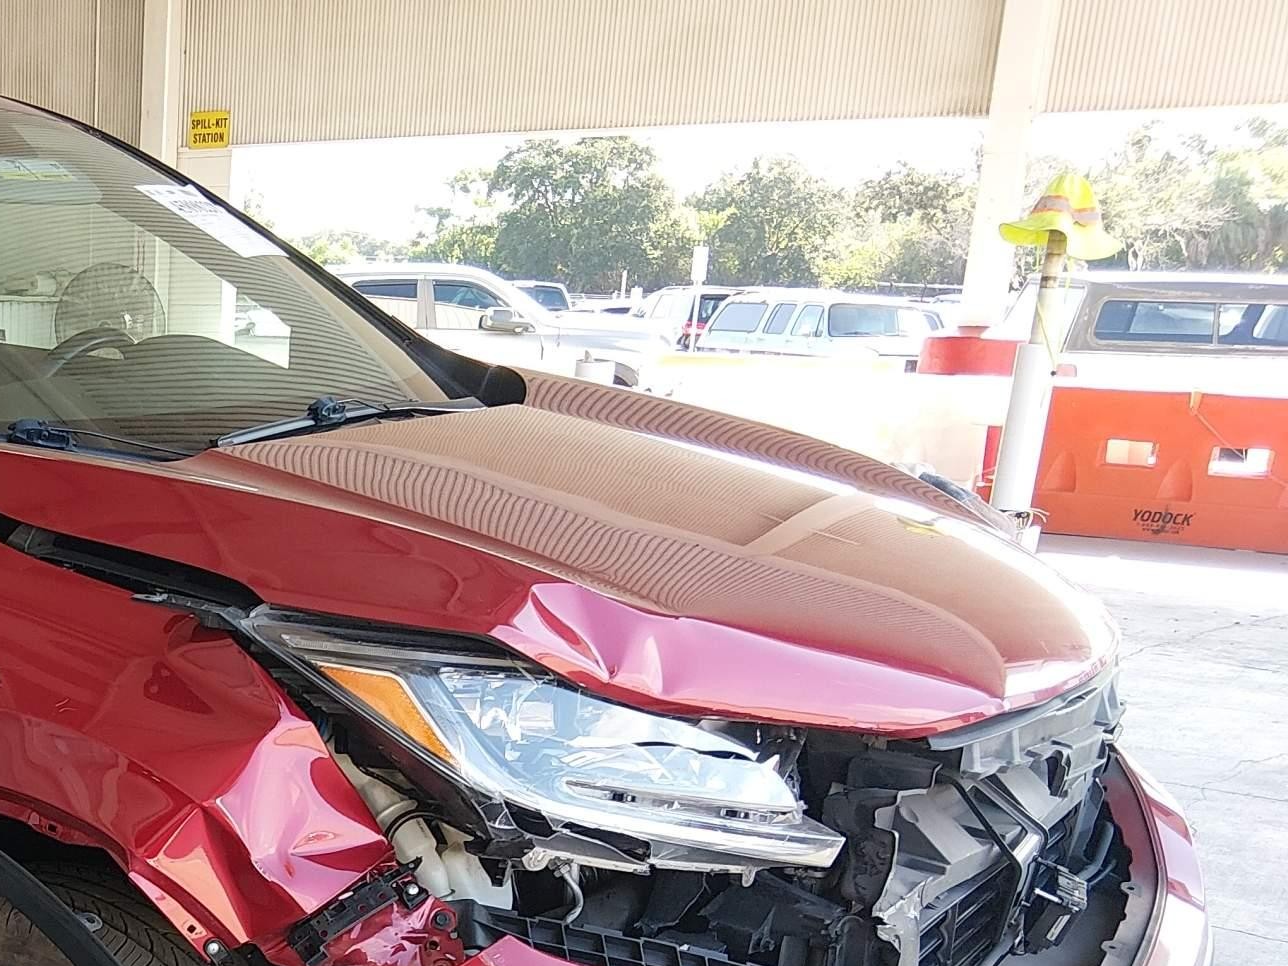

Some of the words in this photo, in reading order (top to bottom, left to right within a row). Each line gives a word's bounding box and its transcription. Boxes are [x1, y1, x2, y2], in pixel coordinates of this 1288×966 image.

[192, 118, 228, 129] SPILL-KIT
[193, 132, 225, 144] STATION
[1133, 508, 1193, 526] YODOCK
